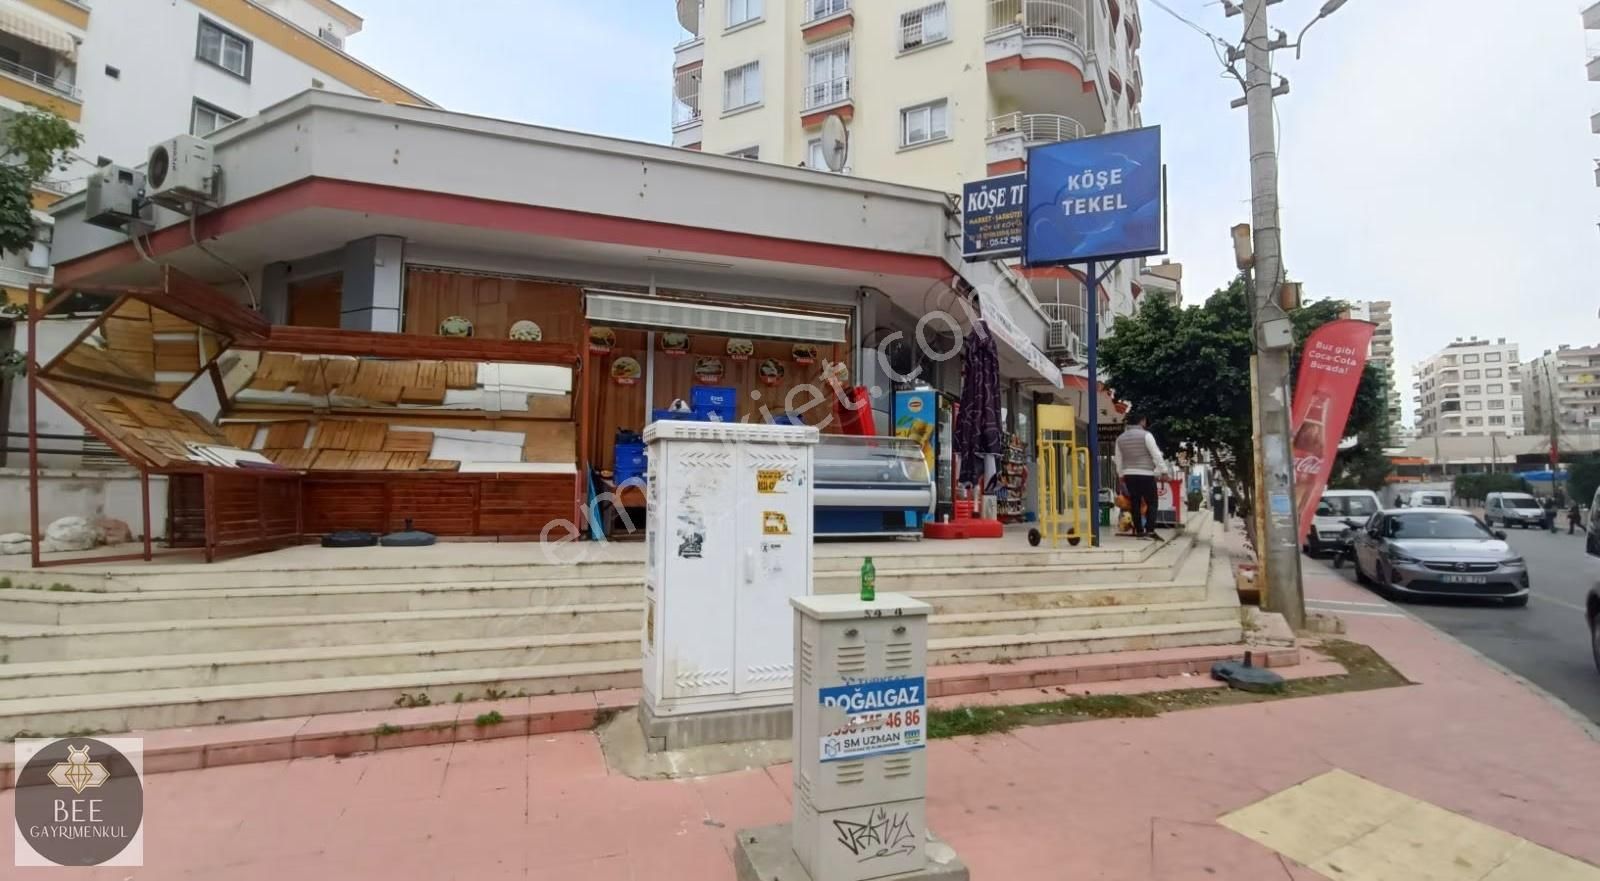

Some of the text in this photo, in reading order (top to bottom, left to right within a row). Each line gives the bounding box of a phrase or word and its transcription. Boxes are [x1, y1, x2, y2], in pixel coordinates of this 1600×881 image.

[1067, 168, 1123, 191] KÖŞE
[967, 185, 1007, 214] KÖŞE
[1062, 193, 1128, 216] TEKEL
[1308, 350, 1357, 366] Coca-Cola
[1315, 341, 1356, 356] Buz gibi
[1310, 360, 1348, 374] Burada!
[824, 686, 920, 711] DOĞALGAZ
[886, 712, 901, 729] 46
[905, 709, 920, 727] 86
[844, 738, 860, 749] SM
[863, 733, 900, 746] UZMAN
